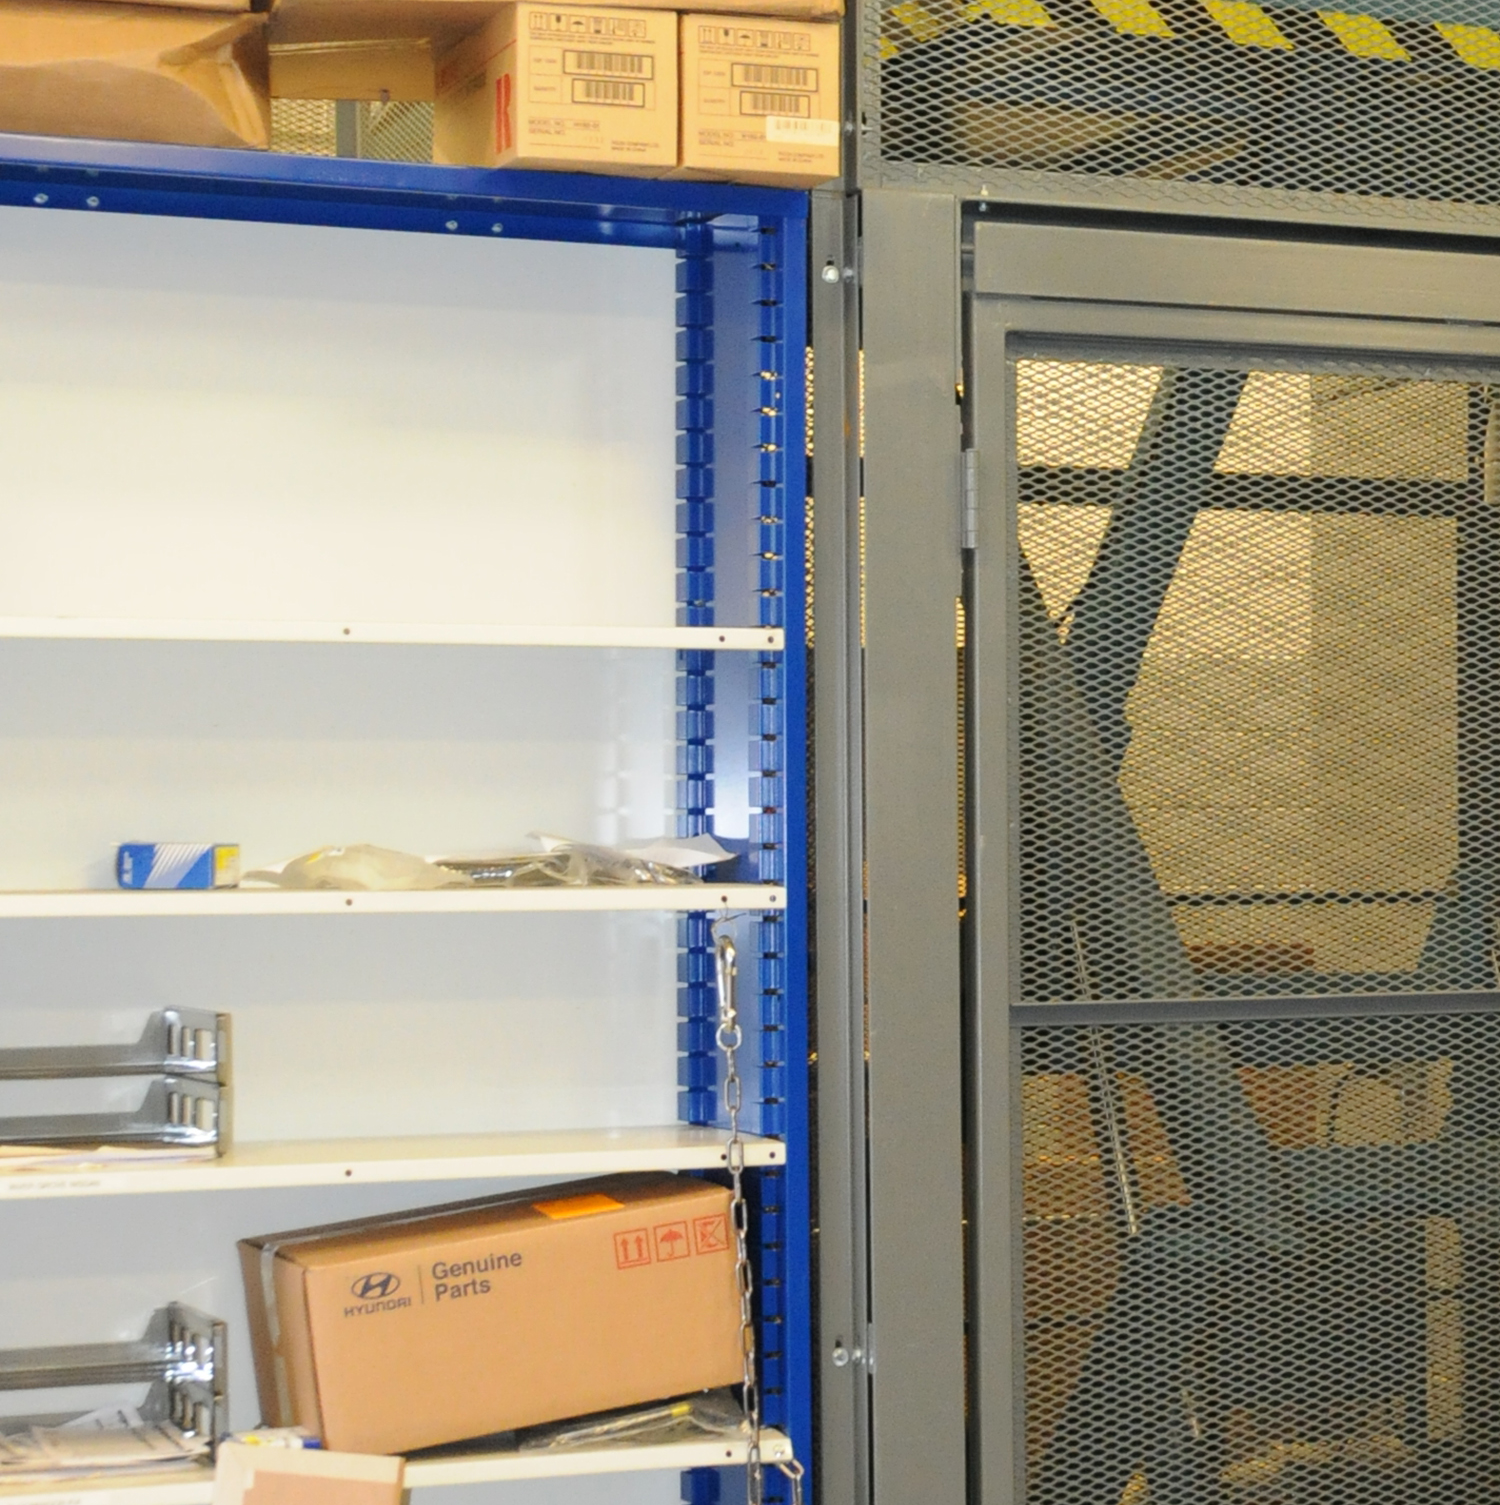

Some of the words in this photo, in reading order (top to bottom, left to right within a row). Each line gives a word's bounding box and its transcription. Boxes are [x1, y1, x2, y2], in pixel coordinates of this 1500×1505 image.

[431, 1252, 523, 1281] Genuine
[434, 1278, 492, 1303] Parts
[343, 1297, 412, 1318] HYUNDAI
